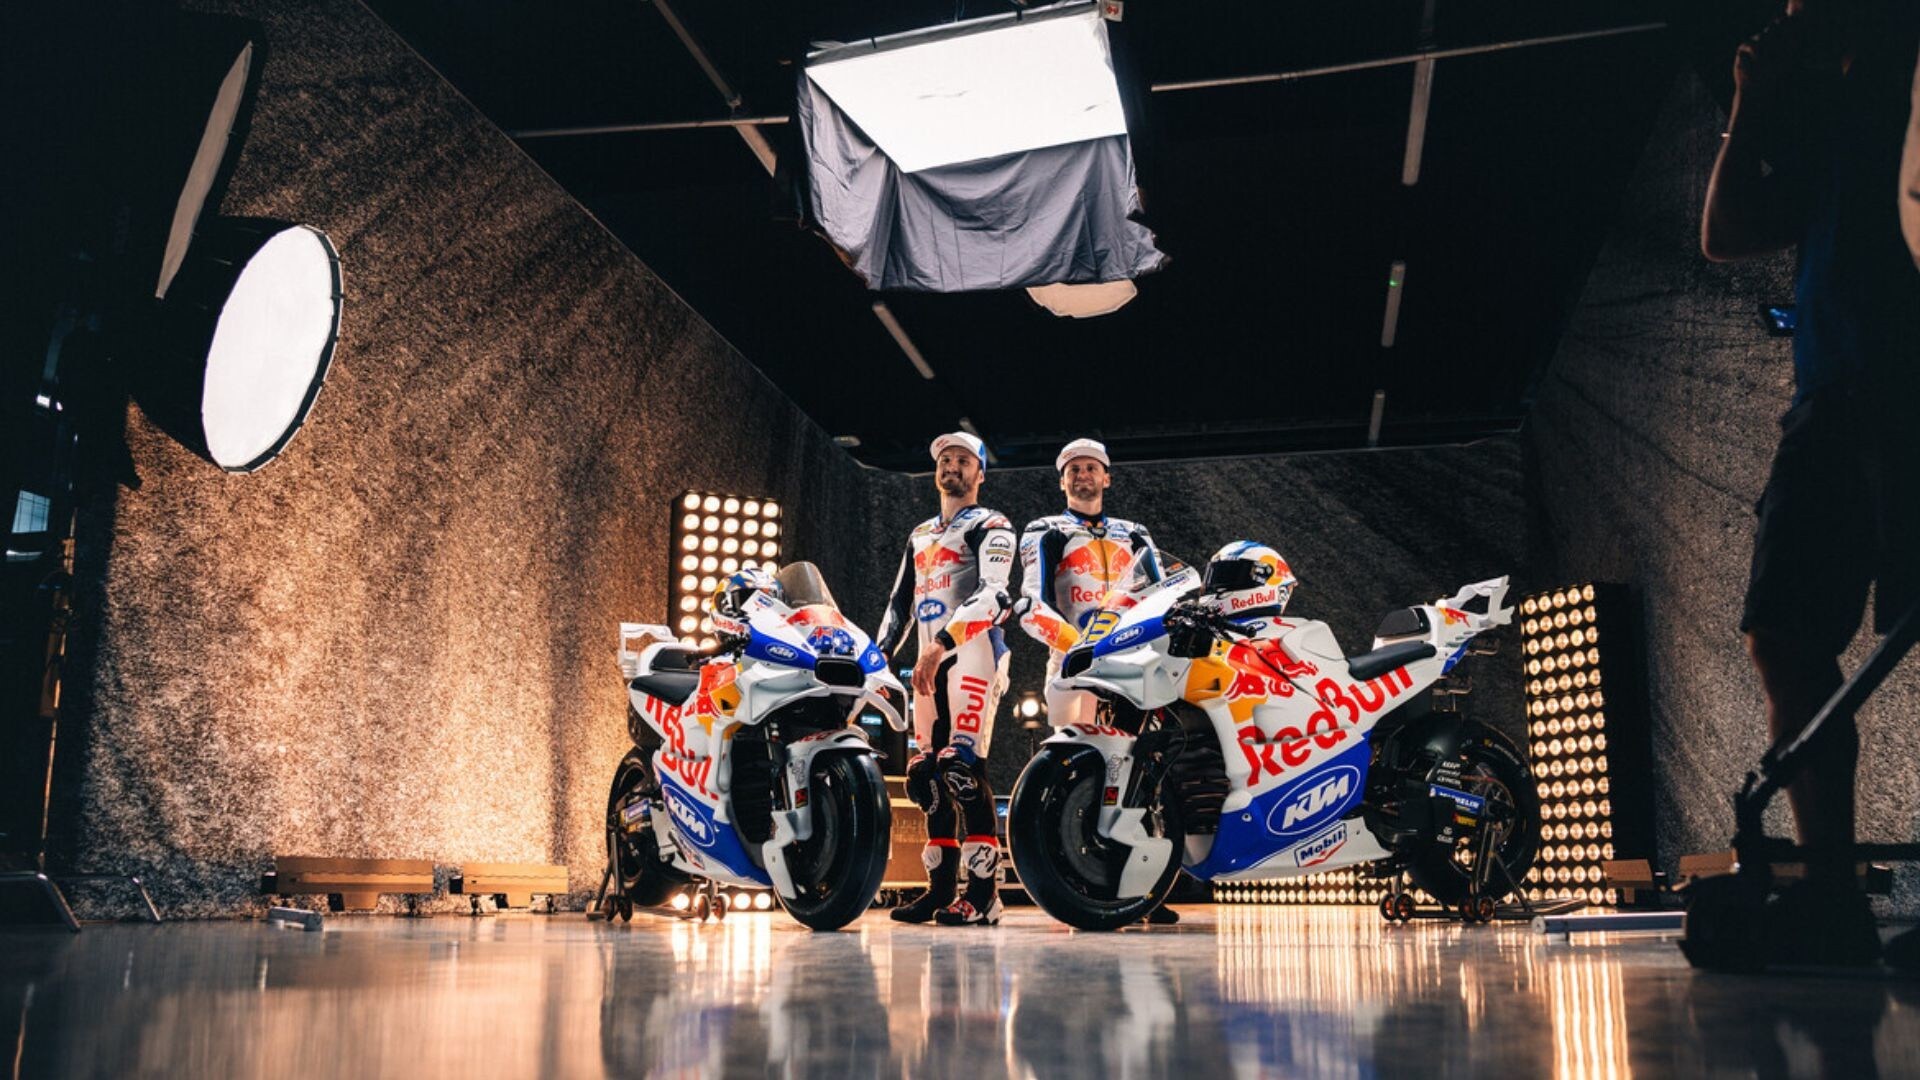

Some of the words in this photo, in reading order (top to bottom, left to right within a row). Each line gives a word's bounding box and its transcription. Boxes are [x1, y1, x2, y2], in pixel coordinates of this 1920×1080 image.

[1070, 584, 1106, 603] Red
[1231, 594, 1254, 610] Red
[1255, 589, 1276, 604] Bull
[956, 675, 988, 734] Bull
[1237, 700, 1348, 788] Red
[1314, 665, 1414, 725] Bull
[667, 795, 706, 840] KTM
[1282, 774, 1350, 830] KTM
[1300, 830, 1343, 861] Mobil
